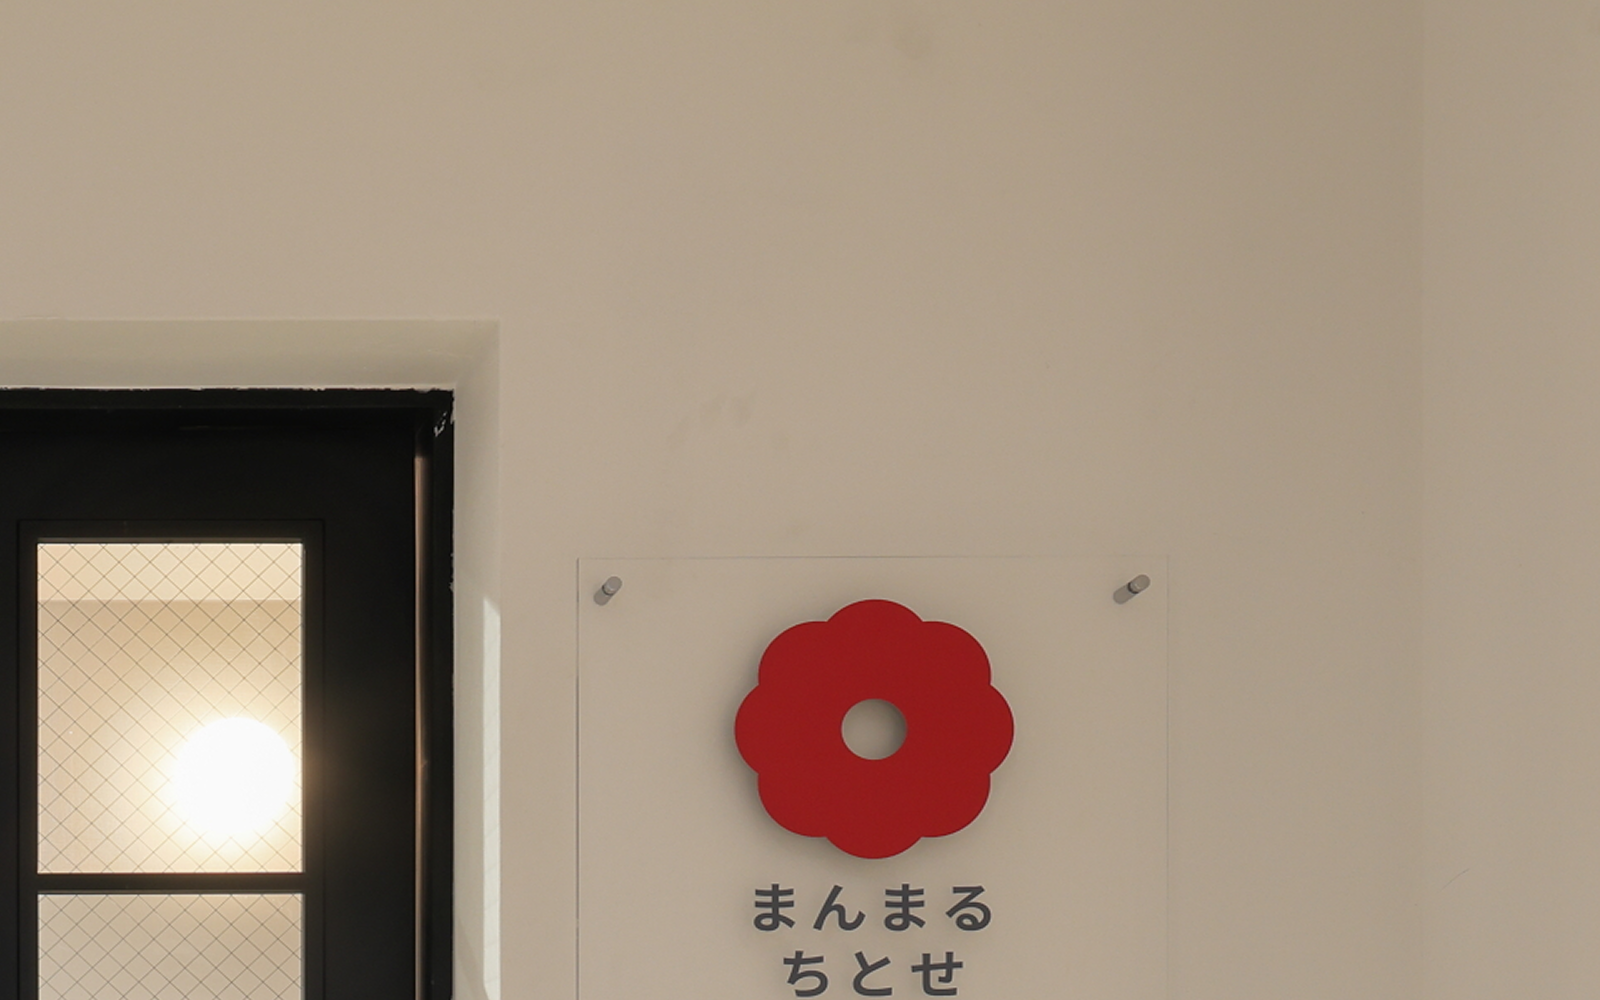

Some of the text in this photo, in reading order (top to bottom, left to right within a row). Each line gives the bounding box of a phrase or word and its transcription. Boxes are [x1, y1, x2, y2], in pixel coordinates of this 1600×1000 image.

[752, 883, 992, 932] まんまる
[782, 950, 965, 998] ちとせ
